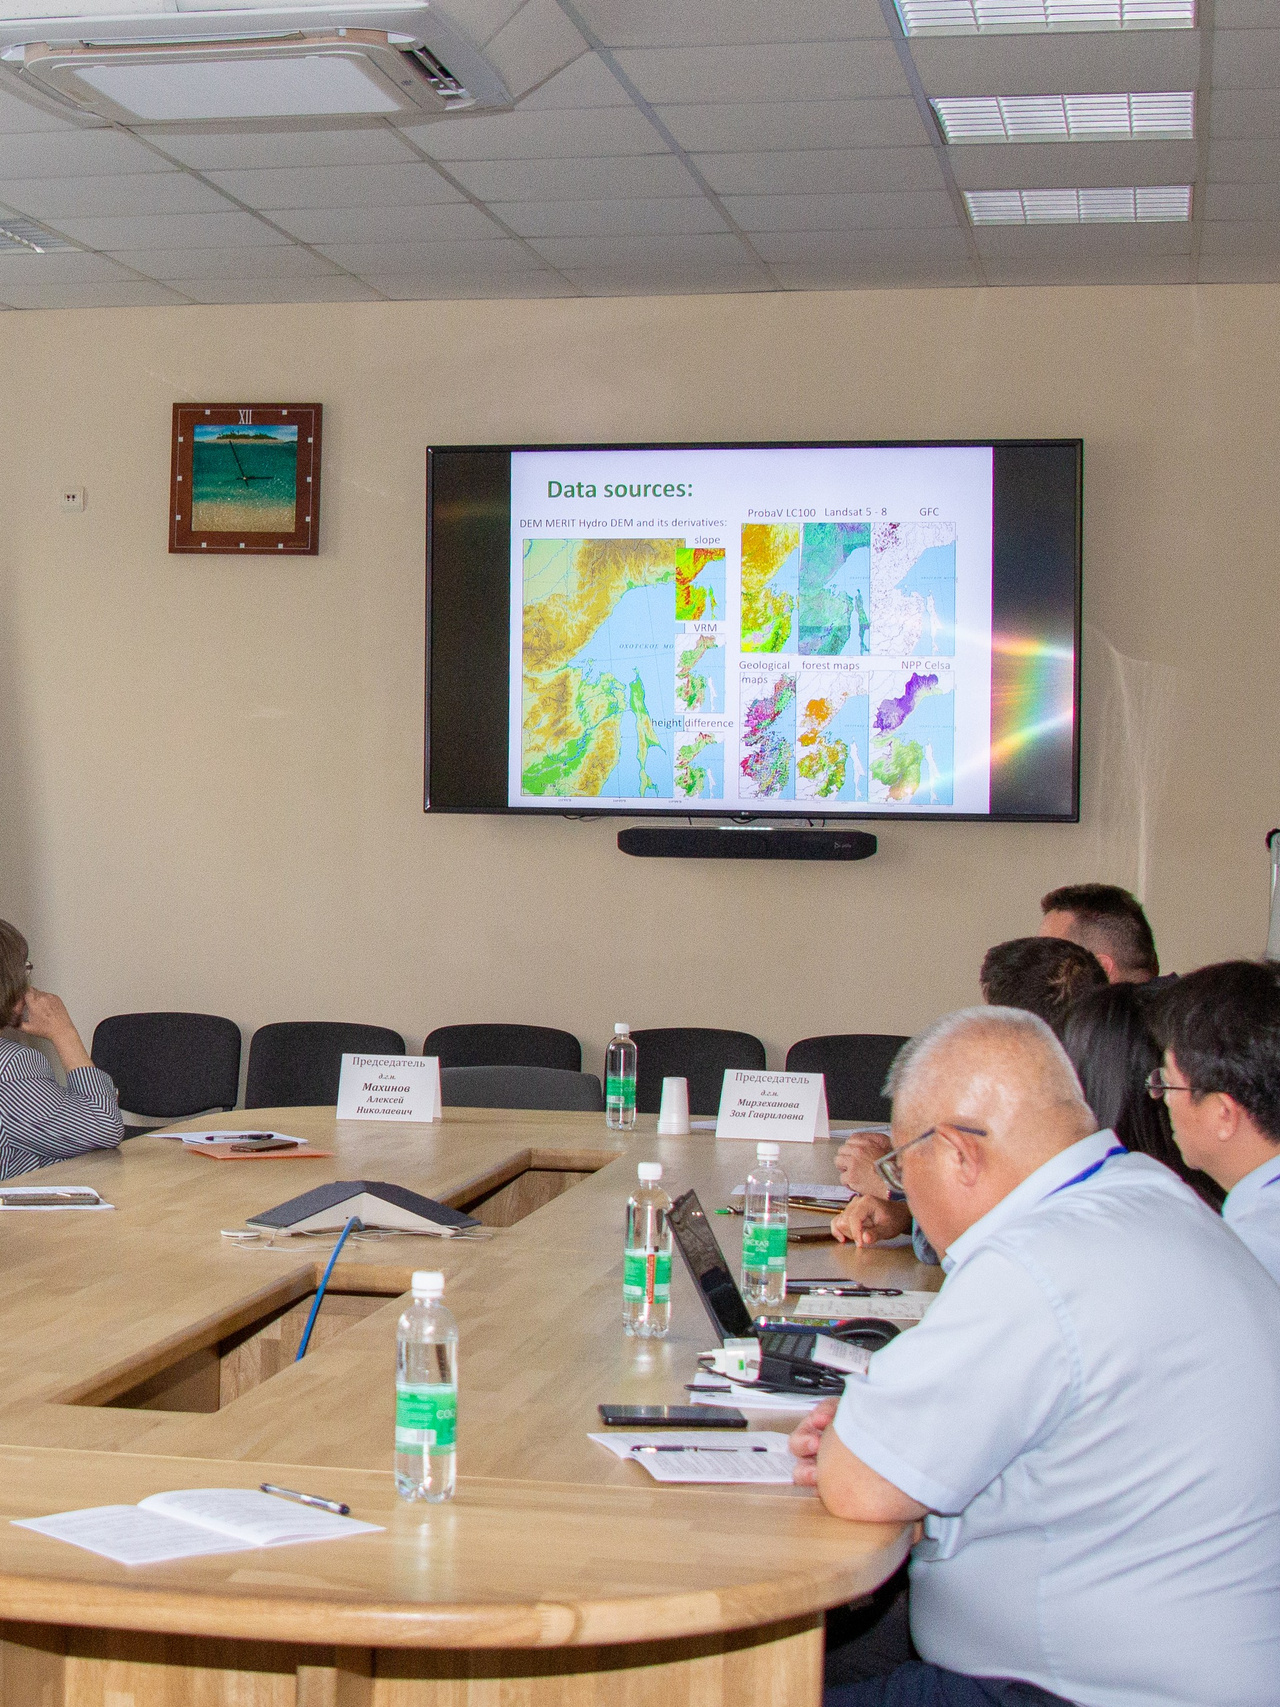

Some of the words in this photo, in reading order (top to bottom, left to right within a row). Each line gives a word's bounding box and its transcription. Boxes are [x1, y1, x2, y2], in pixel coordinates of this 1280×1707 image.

[238, 409, 252, 424] XII
[547, 480, 597, 498] Data
[604, 482, 693, 498] sources:
[748, 508, 784, 518] ProbaV
[786, 508, 816, 518] LC100
[824, 507, 863, 517] Landsat
[865, 507, 871, 517] 5
[881, 507, 887, 517] 8
[919, 507, 940, 517] GFC
[519, 519, 543, 528] DEM
[545, 519, 576, 528] MERIT
[578, 519, 608, 530] Hydro
[610, 519, 634, 528] DEM
[636, 518, 655, 528] and
[657, 518, 669, 528] its
[671, 518, 728, 528] derivatives:
[694, 535, 721, 547] slope
[693, 623, 717, 632] VRM
[738, 660, 790, 671] Geological
[802, 660, 831, 670] forest
[833, 662, 860, 672] maps
[901, 660, 922, 670] NPP
[924, 660, 951, 670] Celsa
[741, 675, 768, 685] maps
[651, 718, 682, 729] height
[684, 718, 734, 728] difference
[352, 1056, 426, 1068] Председатель
[735, 1072, 810, 1085] Председатель
[362, 1082, 411, 1093] Махинов
[366, 1095, 405, 1104] Алексей
[737, 1098, 800, 1109] Мирзеханова
[356, 1106, 413, 1116] Николаевич
[729, 1109, 746, 1118] Зоя
[748, 1110, 804, 1121] Гавриловна
